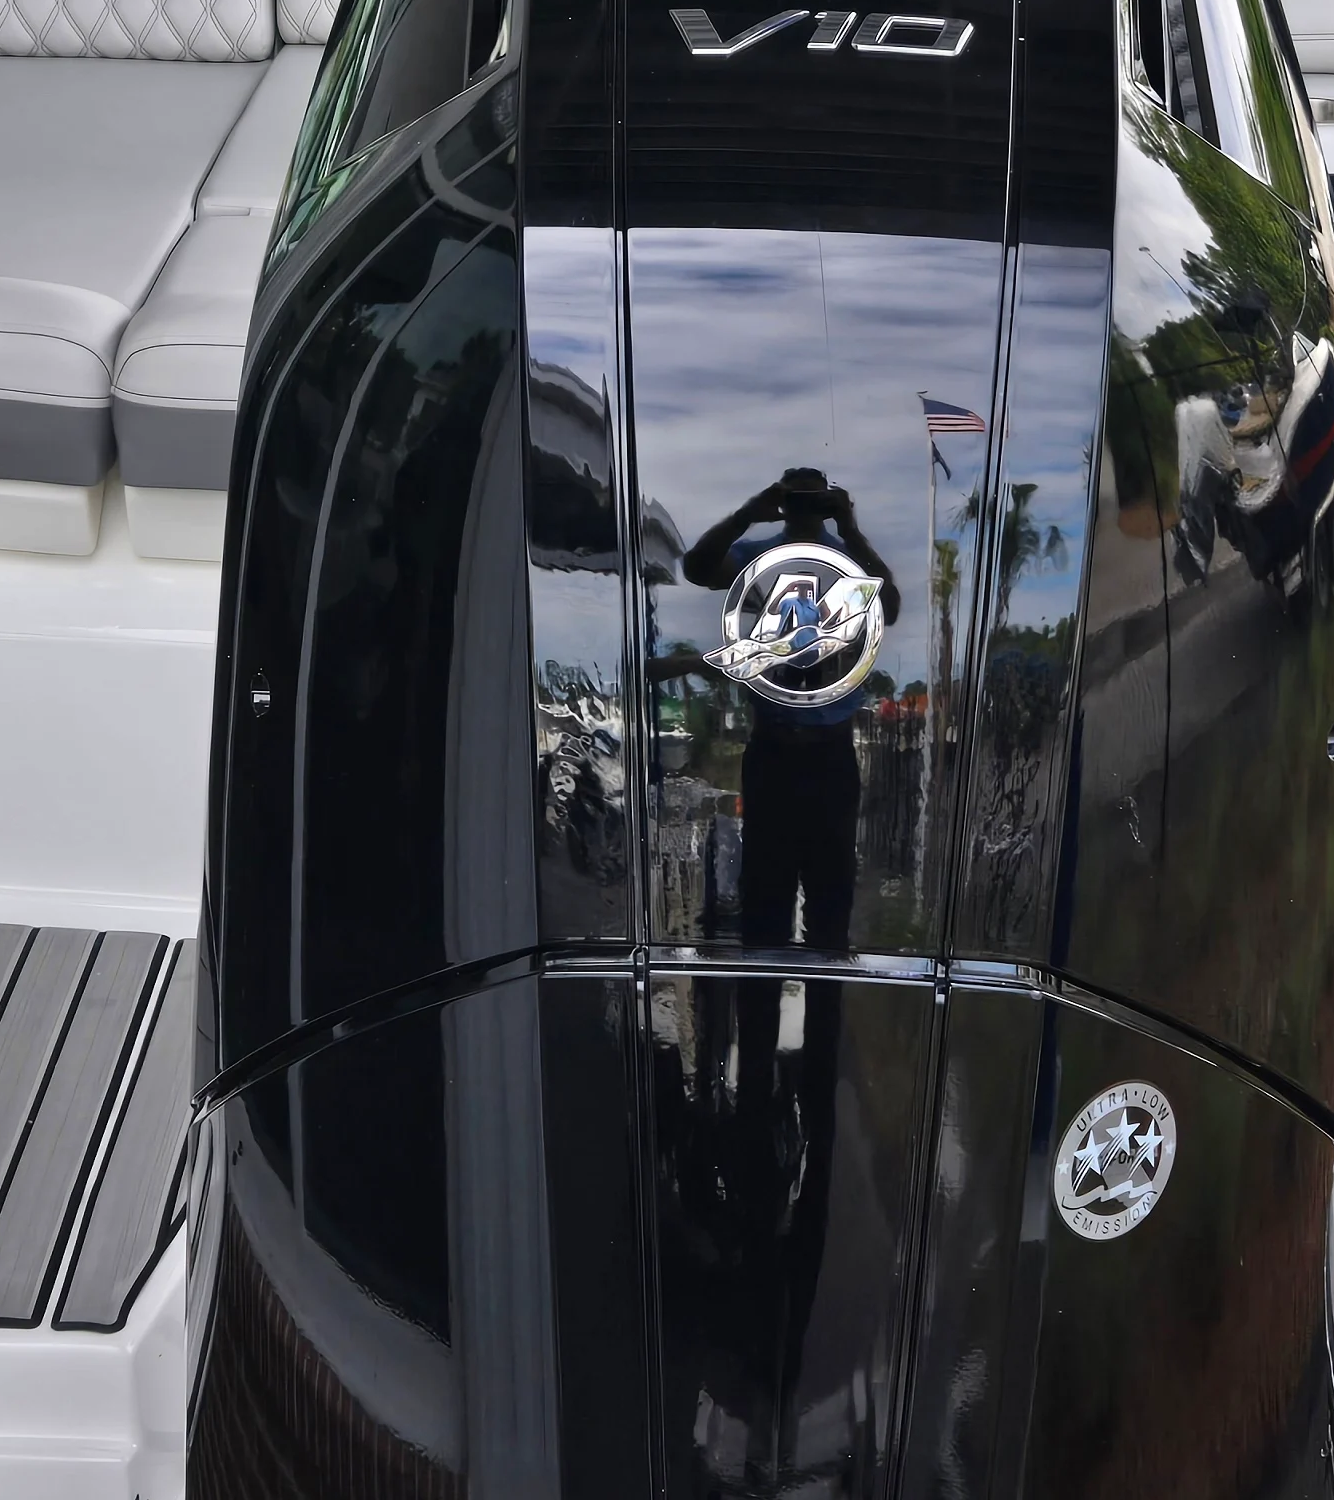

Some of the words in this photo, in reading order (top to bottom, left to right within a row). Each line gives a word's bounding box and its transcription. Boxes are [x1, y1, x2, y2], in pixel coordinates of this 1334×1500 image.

[668, 8, 977, 57] V10
[1076, 1087, 1130, 1133] ULTRA
[1141, 1089, 1170, 1122] LOW
[1072, 1196, 1154, 1235] EMISSION
